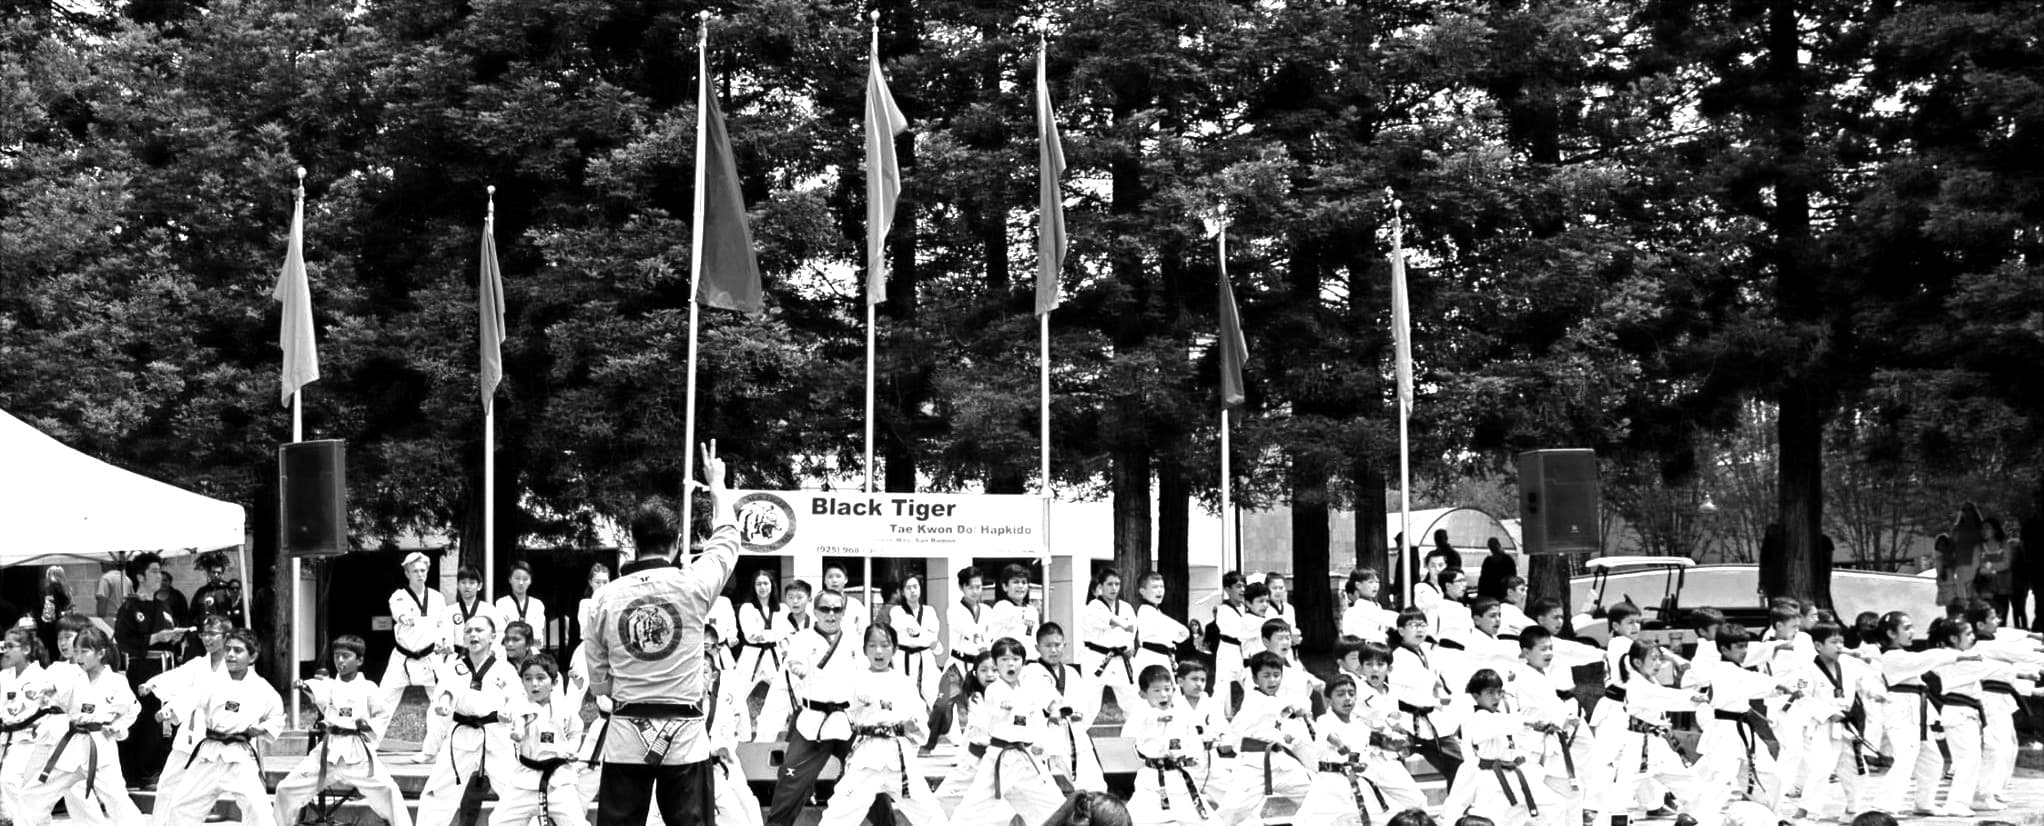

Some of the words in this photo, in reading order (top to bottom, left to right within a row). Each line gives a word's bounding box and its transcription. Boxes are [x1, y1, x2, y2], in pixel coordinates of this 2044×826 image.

[812, 498, 882, 516] Black
[891, 499, 956, 521] Tiger
[889, 524, 913, 534] Tae
[917, 524, 952, 534] Kwon
[980, 524, 1032, 537] Hapkido
